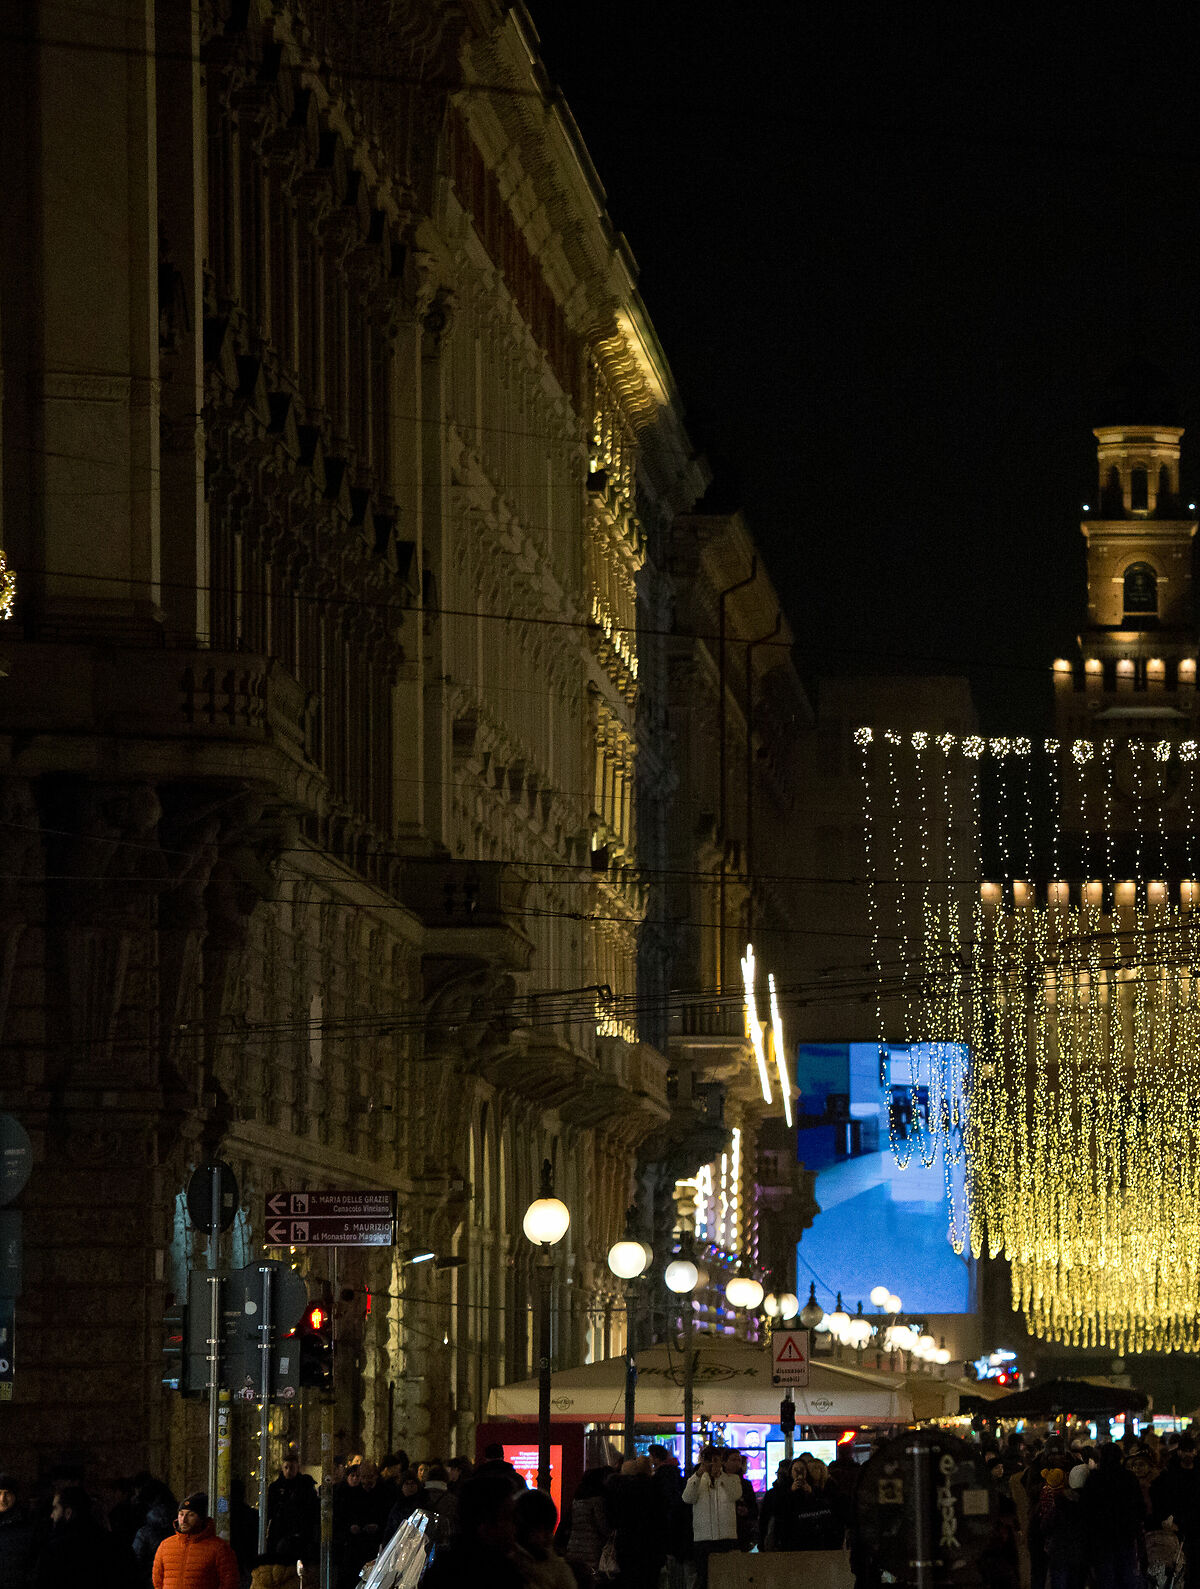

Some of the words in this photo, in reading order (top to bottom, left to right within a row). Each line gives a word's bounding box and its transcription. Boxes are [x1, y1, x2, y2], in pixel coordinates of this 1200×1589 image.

[319, 1195, 341, 1204] MARIA
[342, 1195, 363, 1204] DELLE
[364, 1195, 389, 1204] GRAZIE
[333, 1205, 362, 1213] Cenacolo
[344, 1223, 351, 1231] S.
[353, 1223, 390, 1231] MAURIZIO
[312, 1233, 319, 1241] al
[321, 1233, 357, 1241] Monastero
[358, 1233, 390, 1242] Maggiore
